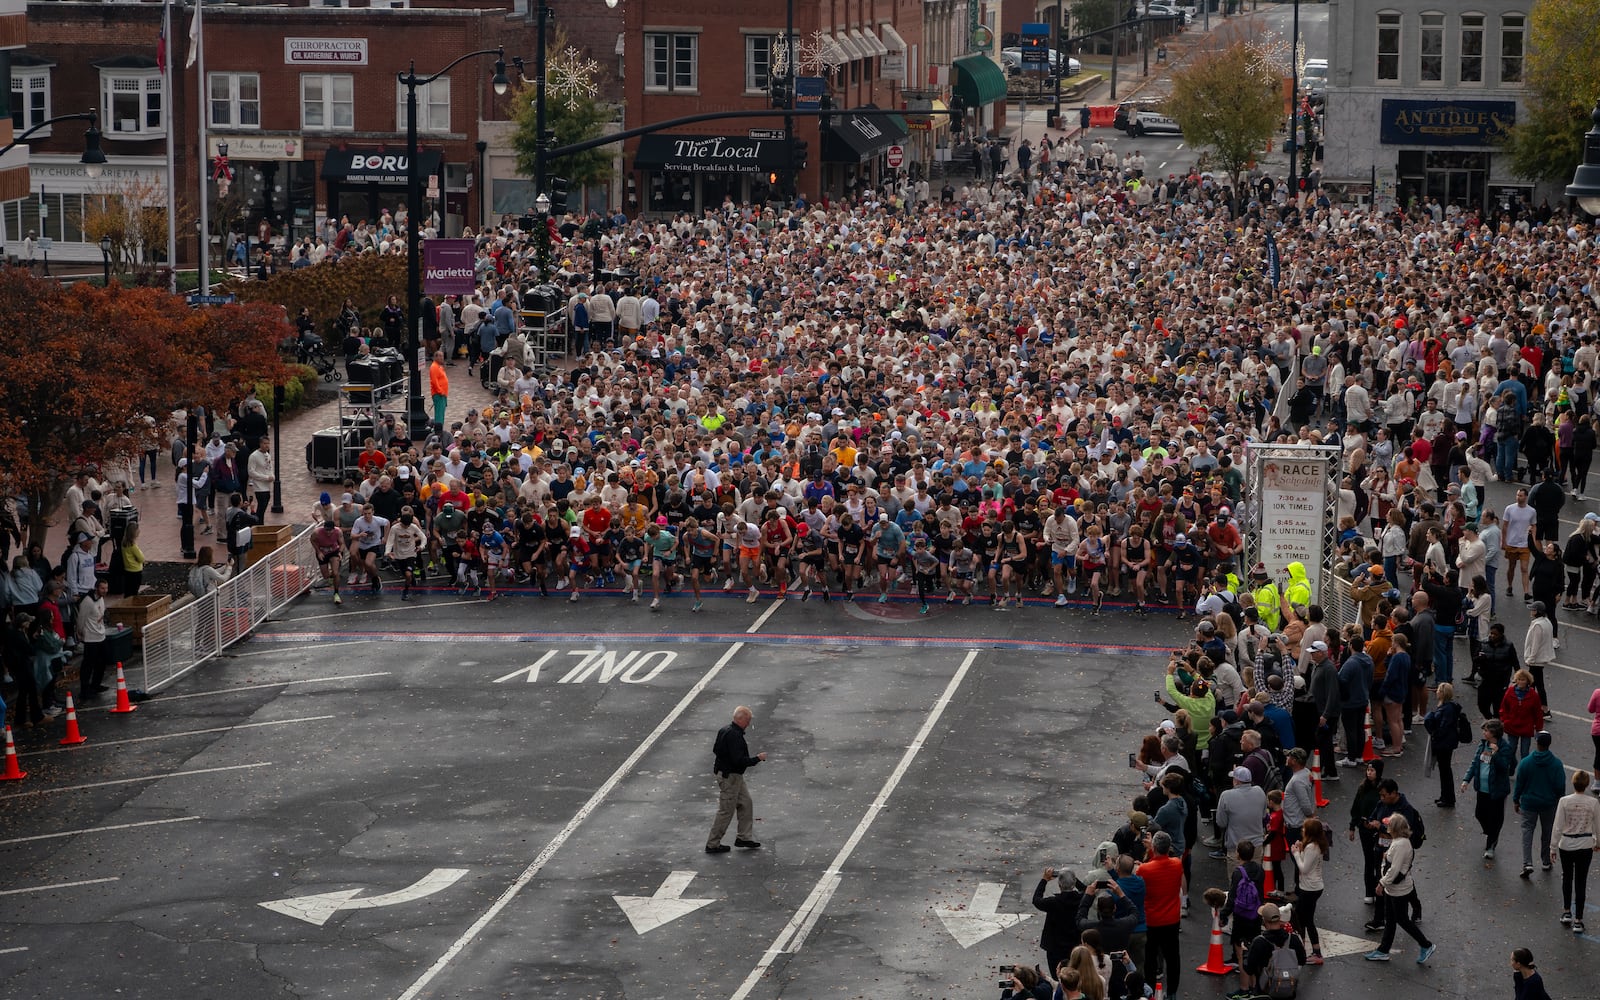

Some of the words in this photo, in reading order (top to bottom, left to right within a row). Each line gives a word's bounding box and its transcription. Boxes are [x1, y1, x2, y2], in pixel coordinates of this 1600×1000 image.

[290, 41, 361, 50] CHIROPRACTOR
[304, 52, 333, 60] KATHERINE
[1394, 109, 1502, 135] ANTIQUES
[695, 136, 727, 146] MARIETTA
[674, 140, 708, 157] The
[711, 141, 761, 158] Local
[350, 155, 408, 171] BORU
[664, 162, 691, 172] Serving
[693, 163, 727, 171] Breakfast
[736, 164, 760, 172] Lunch
[31, 167, 47, 176] ITY
[101, 169, 140, 177] ARIETTA
[427, 267, 473, 279] Marietta
[1283, 465, 1320, 475] RACE
[1280, 475, 1321, 488] Schedule
[1289, 503, 1313, 511] TIMED
[1280, 528, 1316, 536] UNTIMED
[492, 650, 678, 683] ONLY
